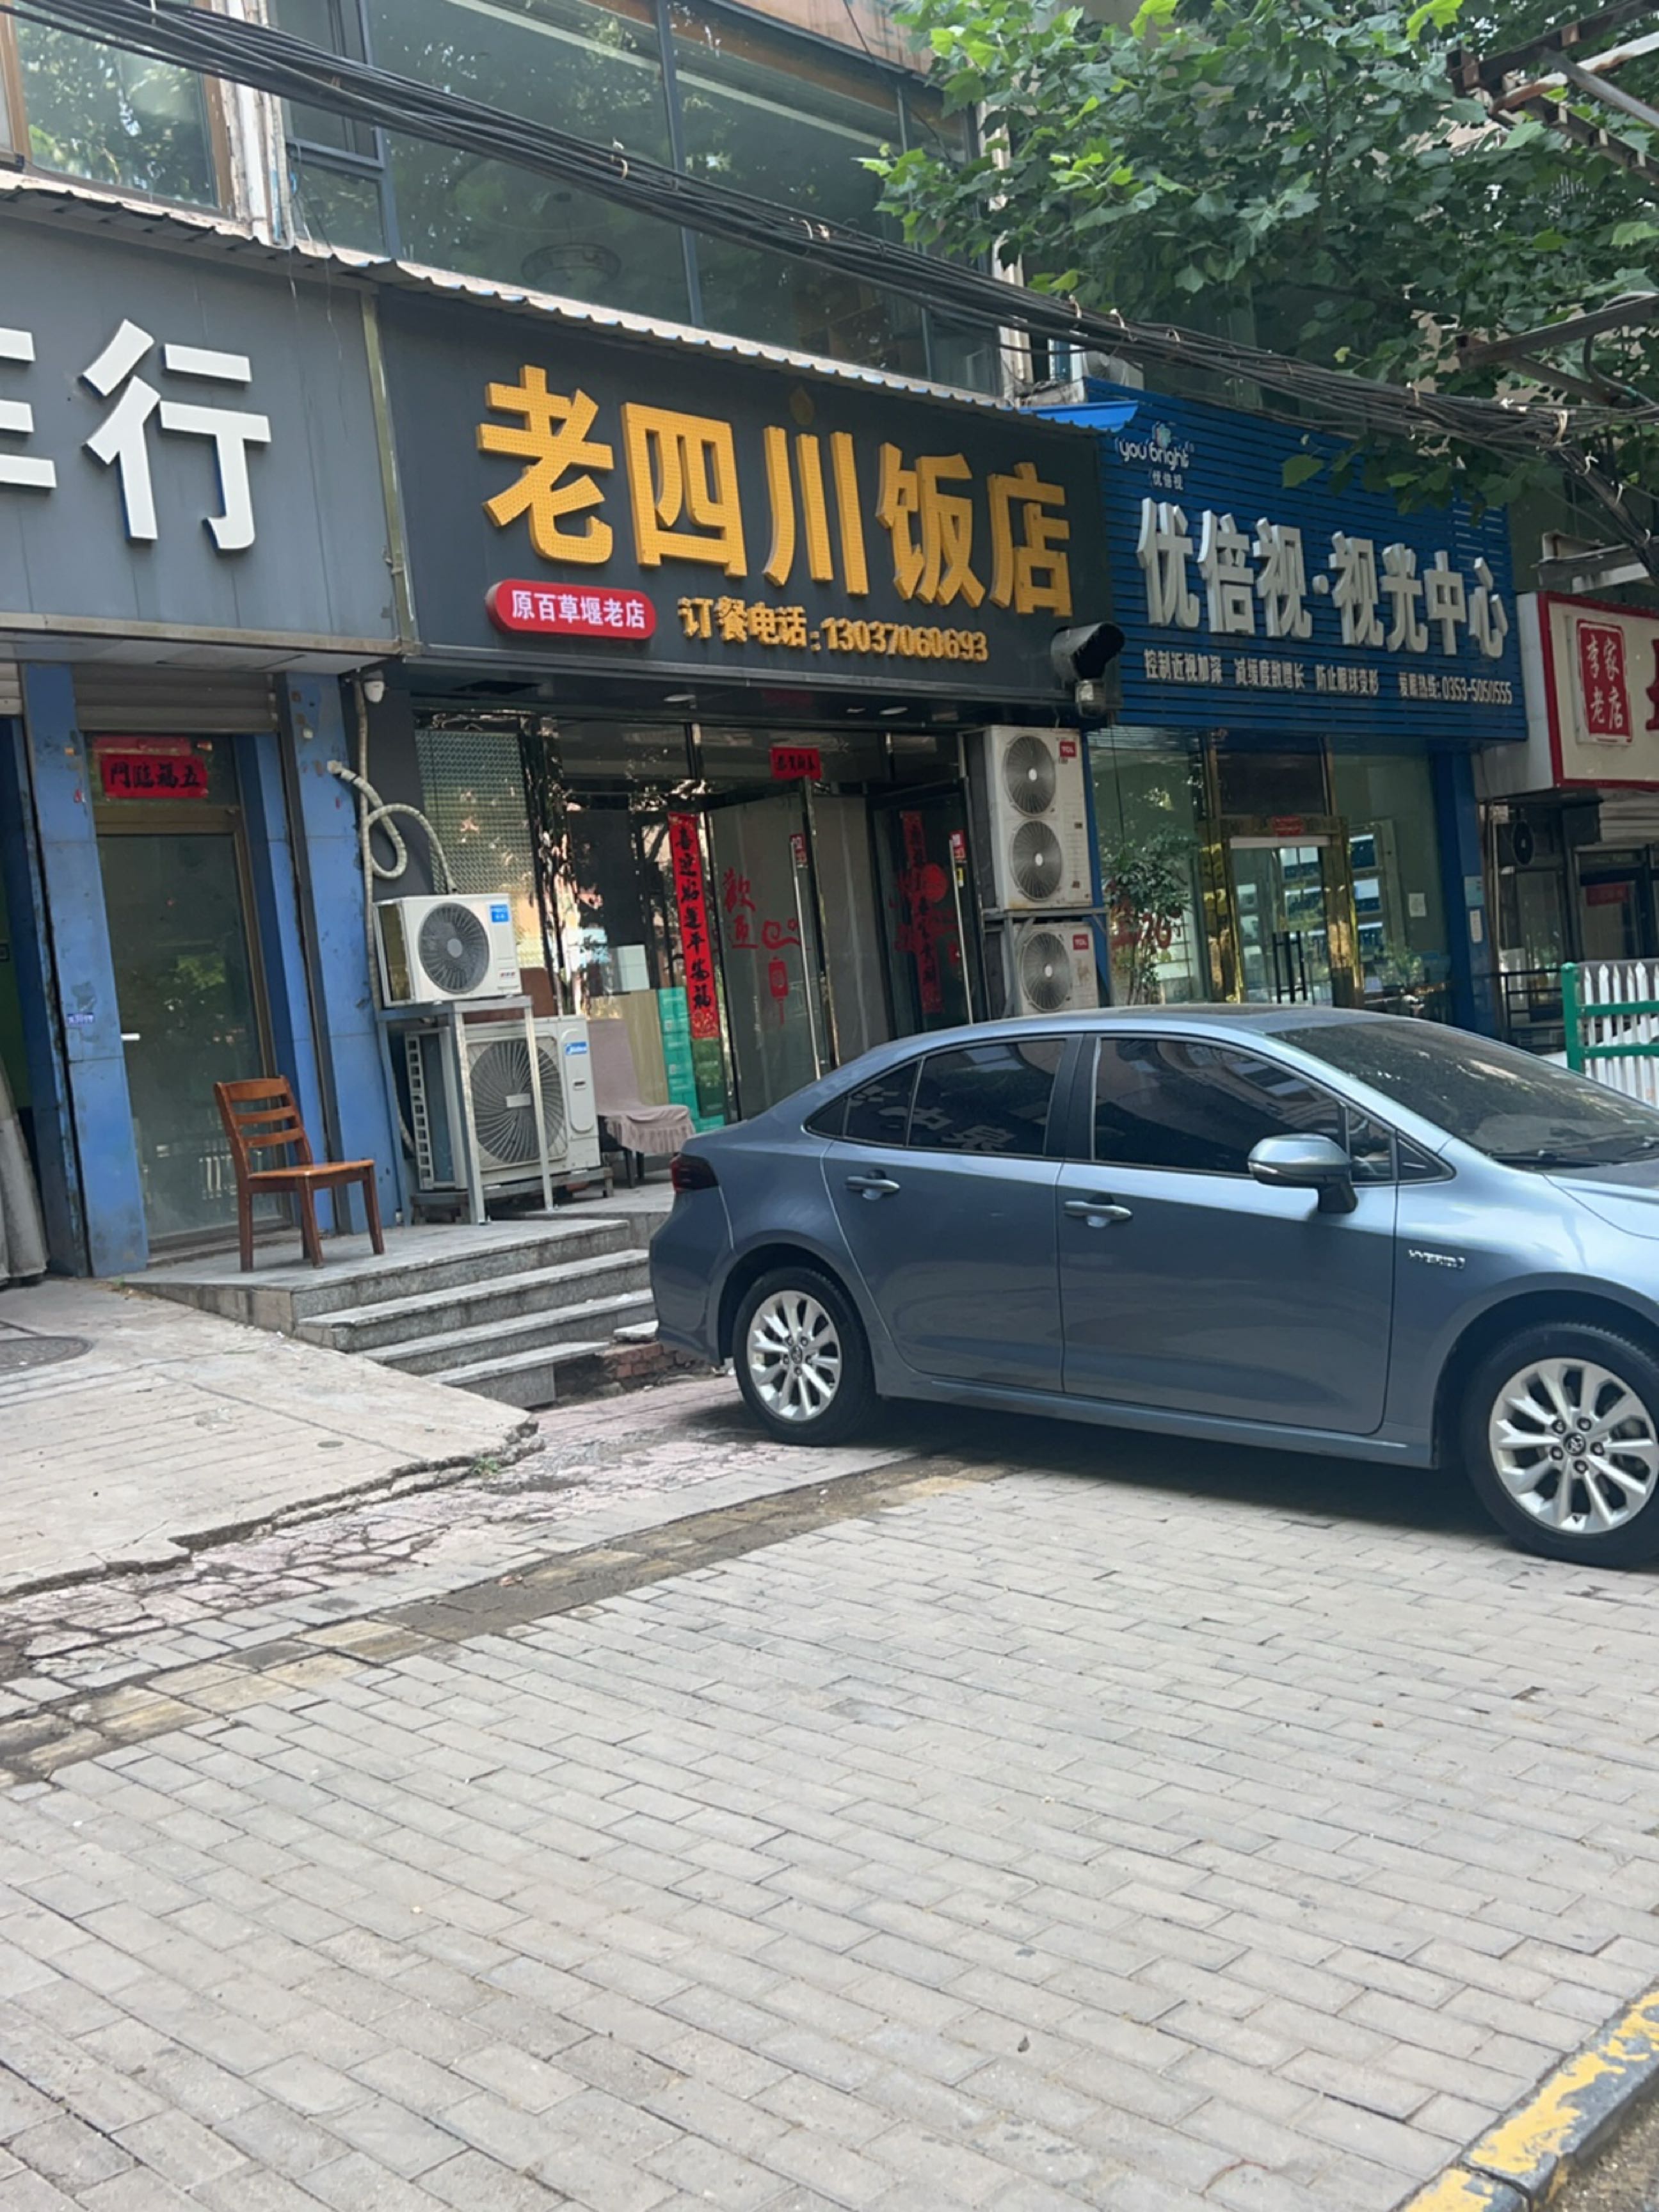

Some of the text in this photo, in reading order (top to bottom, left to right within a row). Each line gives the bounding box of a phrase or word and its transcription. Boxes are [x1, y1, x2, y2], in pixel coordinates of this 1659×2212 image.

[477, 365, 1071, 616] 老四川饭店
[511, 589, 646, 629] 原百草堰老店
[1144, 648, 1222, 684] 控制近视加深
[1315, 664, 1379, 696] 防止眼球变形
